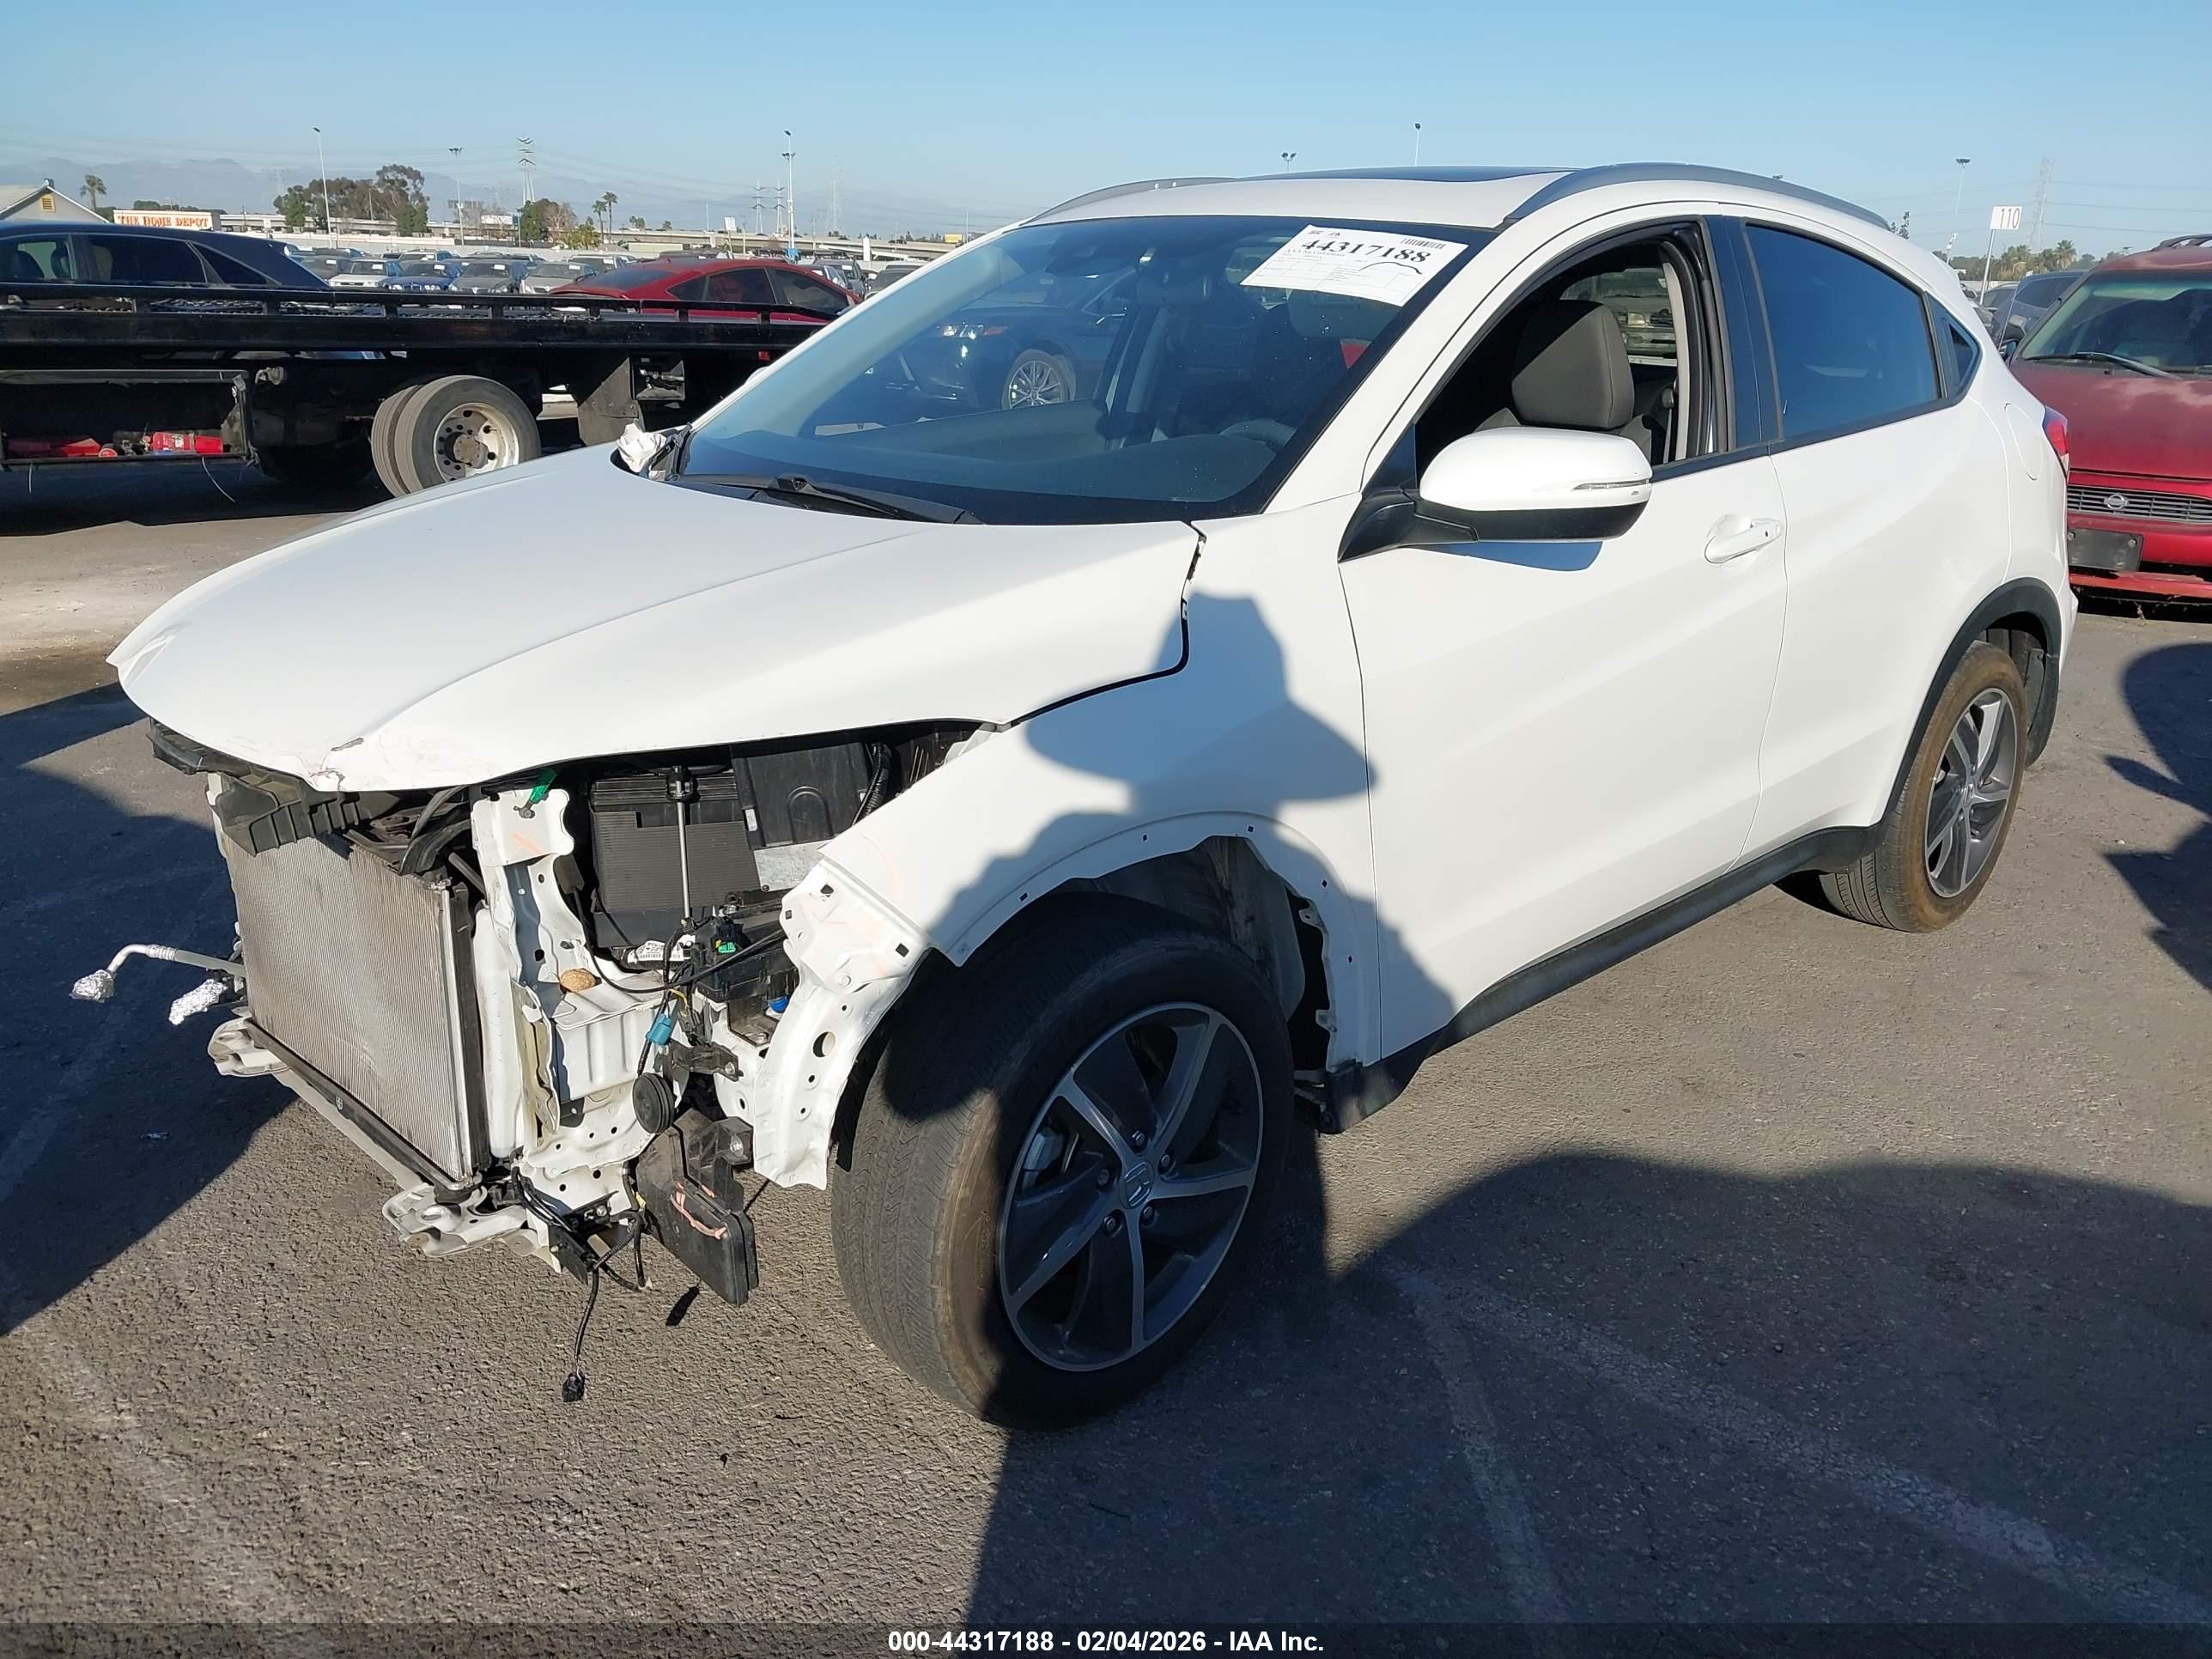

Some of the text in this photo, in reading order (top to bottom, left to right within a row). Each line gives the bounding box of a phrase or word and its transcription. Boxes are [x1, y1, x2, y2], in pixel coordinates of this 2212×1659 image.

[118, 216, 209, 228] THE HOME DEPOT
[2000, 208, 2020, 228] 110
[1302, 240, 1431, 263] 44317188
